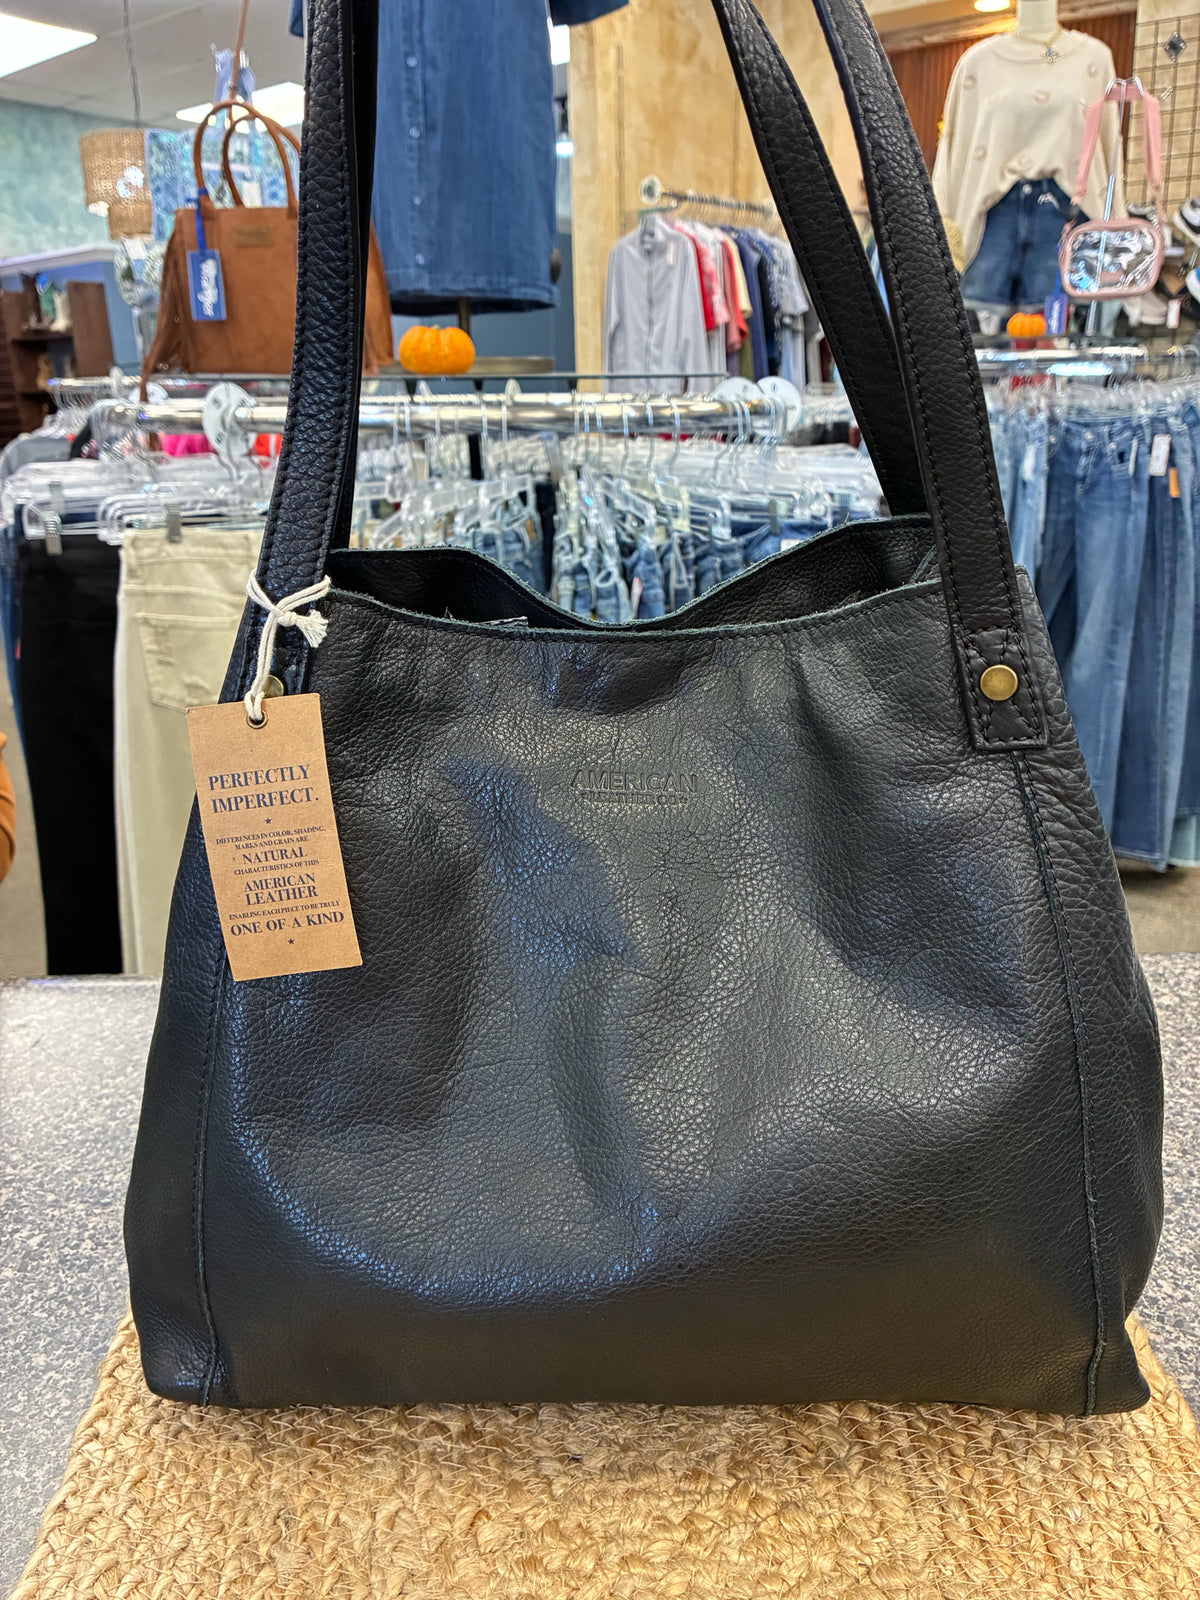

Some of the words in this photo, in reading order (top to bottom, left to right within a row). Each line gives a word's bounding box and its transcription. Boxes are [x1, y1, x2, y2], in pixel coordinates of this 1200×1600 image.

[208, 764, 310, 791] PERFECTLY
[570, 769, 698, 793] AMERICAN
[212, 787, 319, 813] IMPERFECT.
[216, 833, 260, 845] DIFFERENCES
[268, 829, 294, 838] COLOR,
[235, 842, 258, 850] MARKS
[258, 840, 273, 848] AND
[274, 838, 295, 846] GRAIN
[242, 846, 308, 865] NATURAL
[234, 863, 294, 876] CHARACTERISTICS
[304, 859, 320, 867] THIS
[244, 873, 316, 892] AMERICAN
[245, 885, 319, 906] LEATHER
[229, 911, 262, 921] ENABLING
[262, 908, 281, 917] EACH
[281, 906, 300, 914] PIECE
[319, 900, 340, 909] TRULY
[230, 921, 263, 937] ONE
[266, 918, 287, 932] OF
[291, 917, 303, 929] A
[306, 911, 345, 926] KIND
